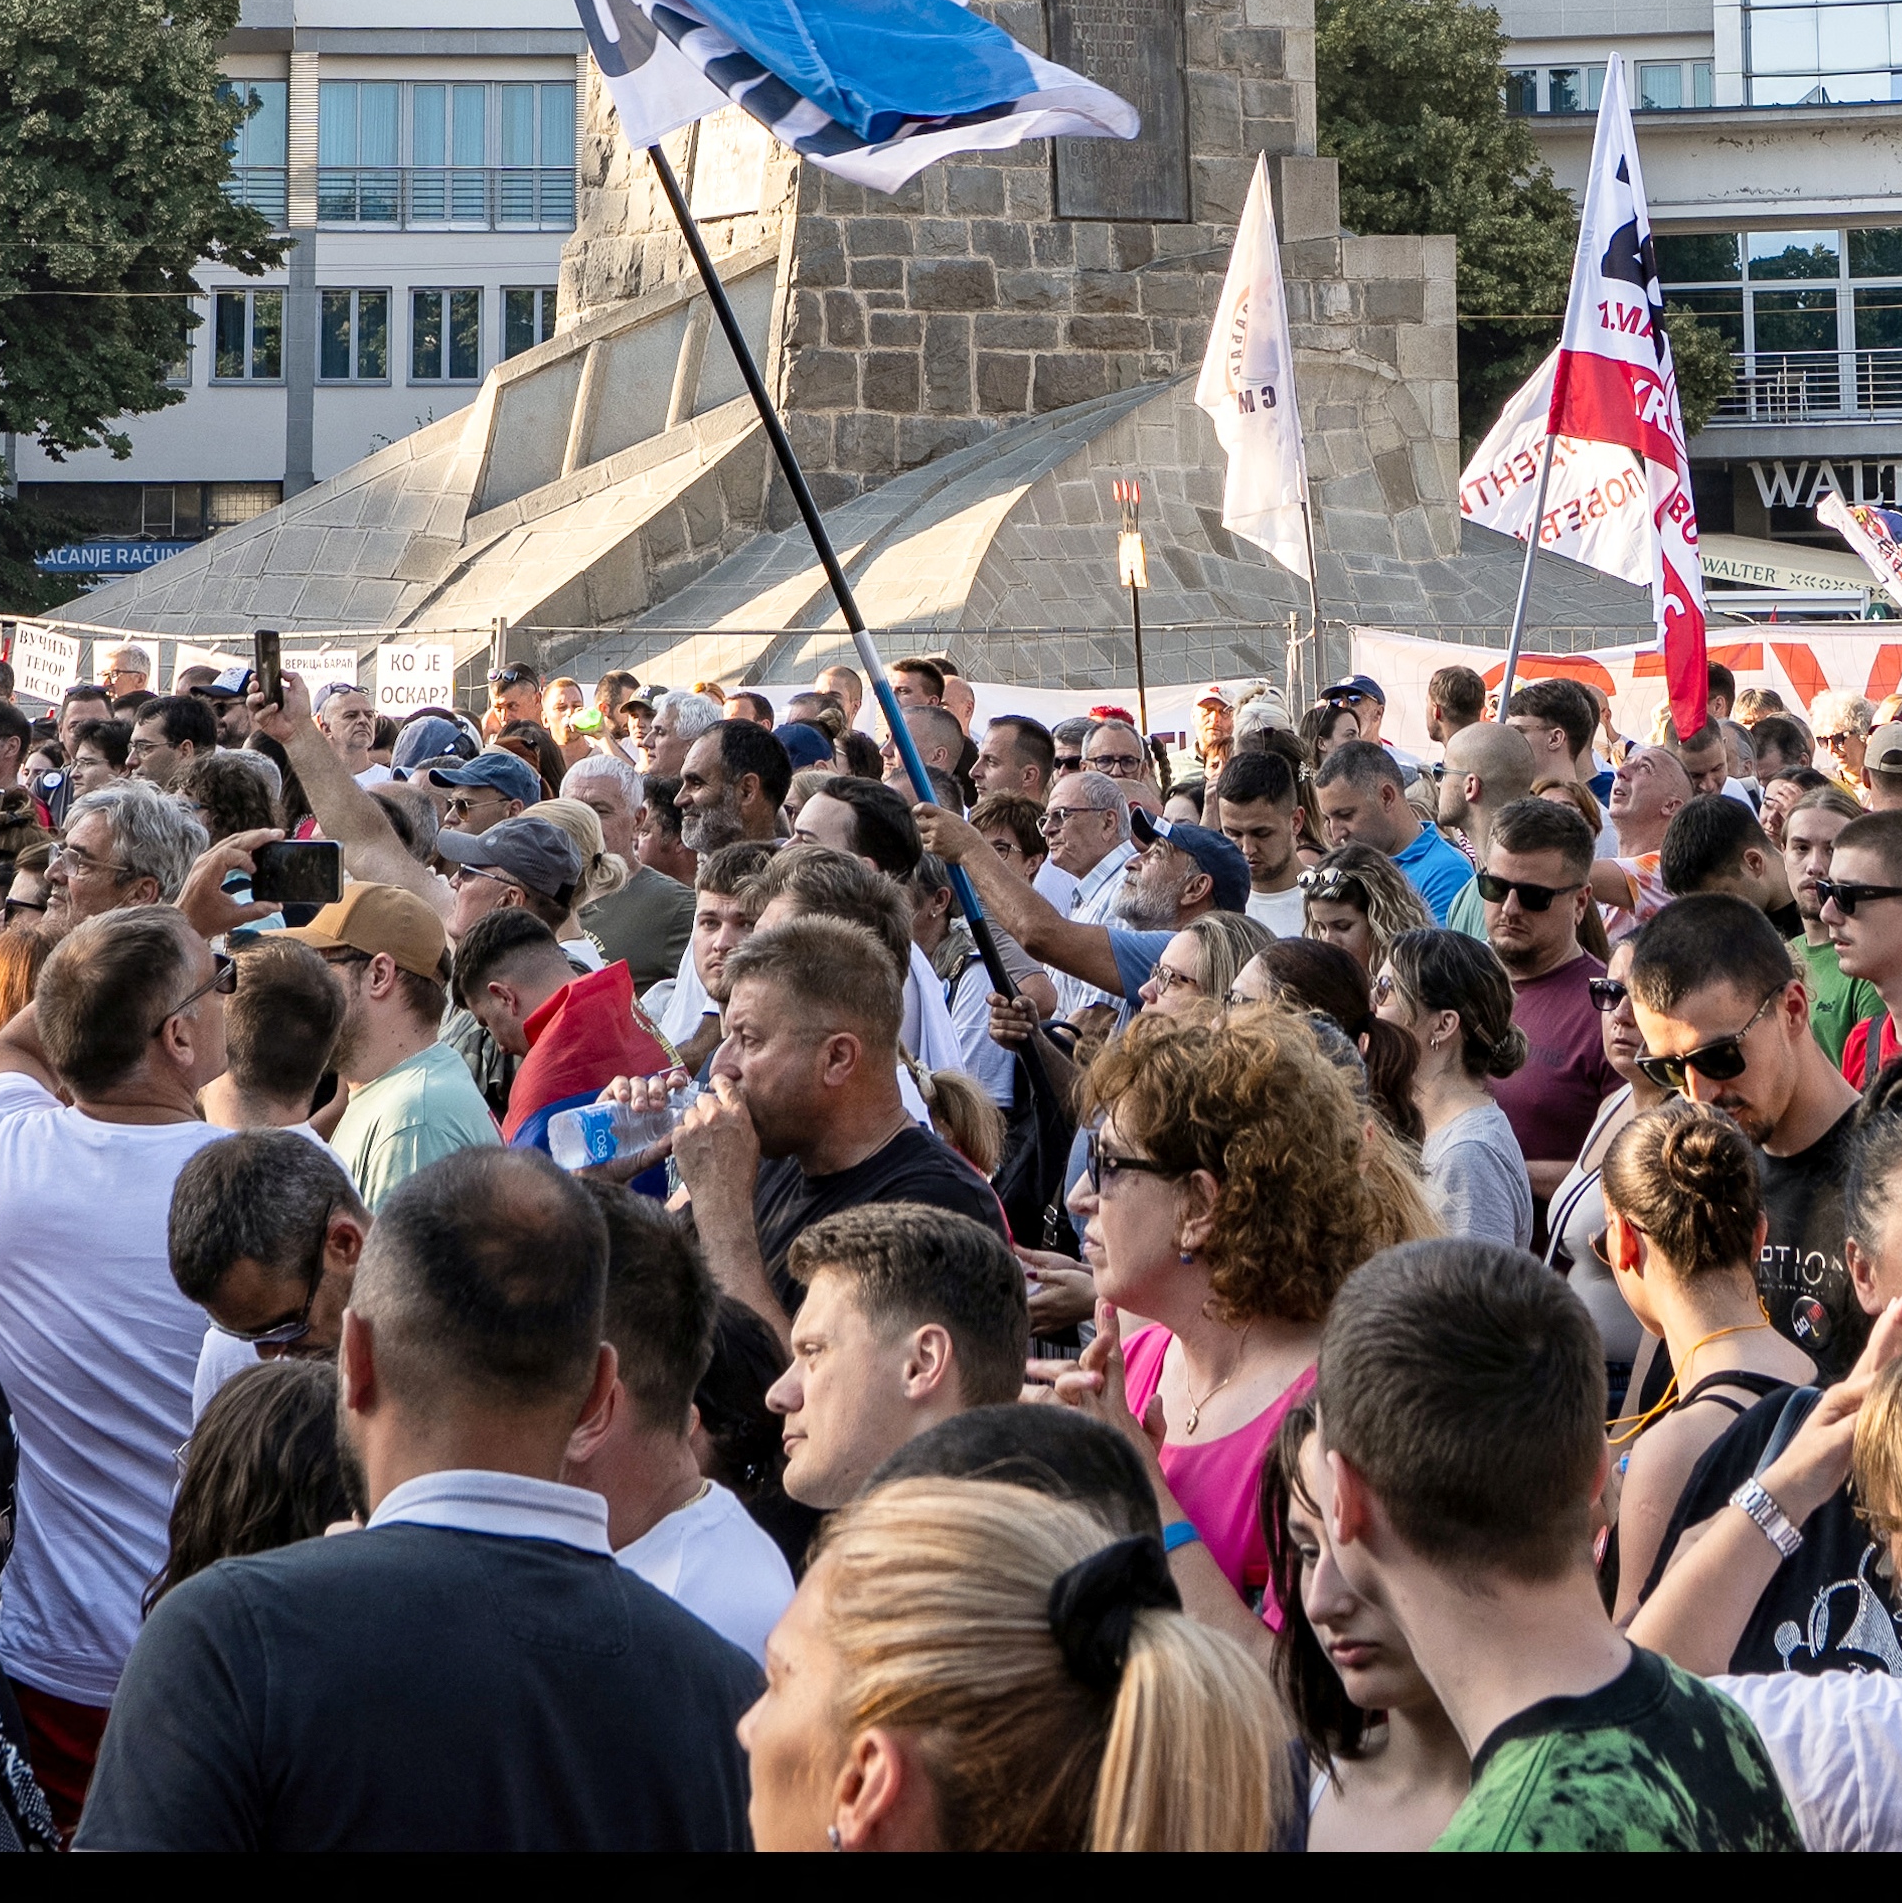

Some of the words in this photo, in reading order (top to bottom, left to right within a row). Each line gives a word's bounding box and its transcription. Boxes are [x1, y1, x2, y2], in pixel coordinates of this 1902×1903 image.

[33, 546, 111, 567] LAĆANJE
[116, 544, 191, 564] RAČUN
[1701, 555, 1776, 584] WALTER
[19, 629, 76, 659] ВУЧИЋУ
[25, 653, 65, 678] ТЕРОР
[391, 653, 415, 672] КО
[425, 653, 441, 672] ЈЕ
[24, 674, 61, 698] ИСТО
[381, 686, 449, 705] ОСКАР?
[595, 1128, 608, 1160] rosa
